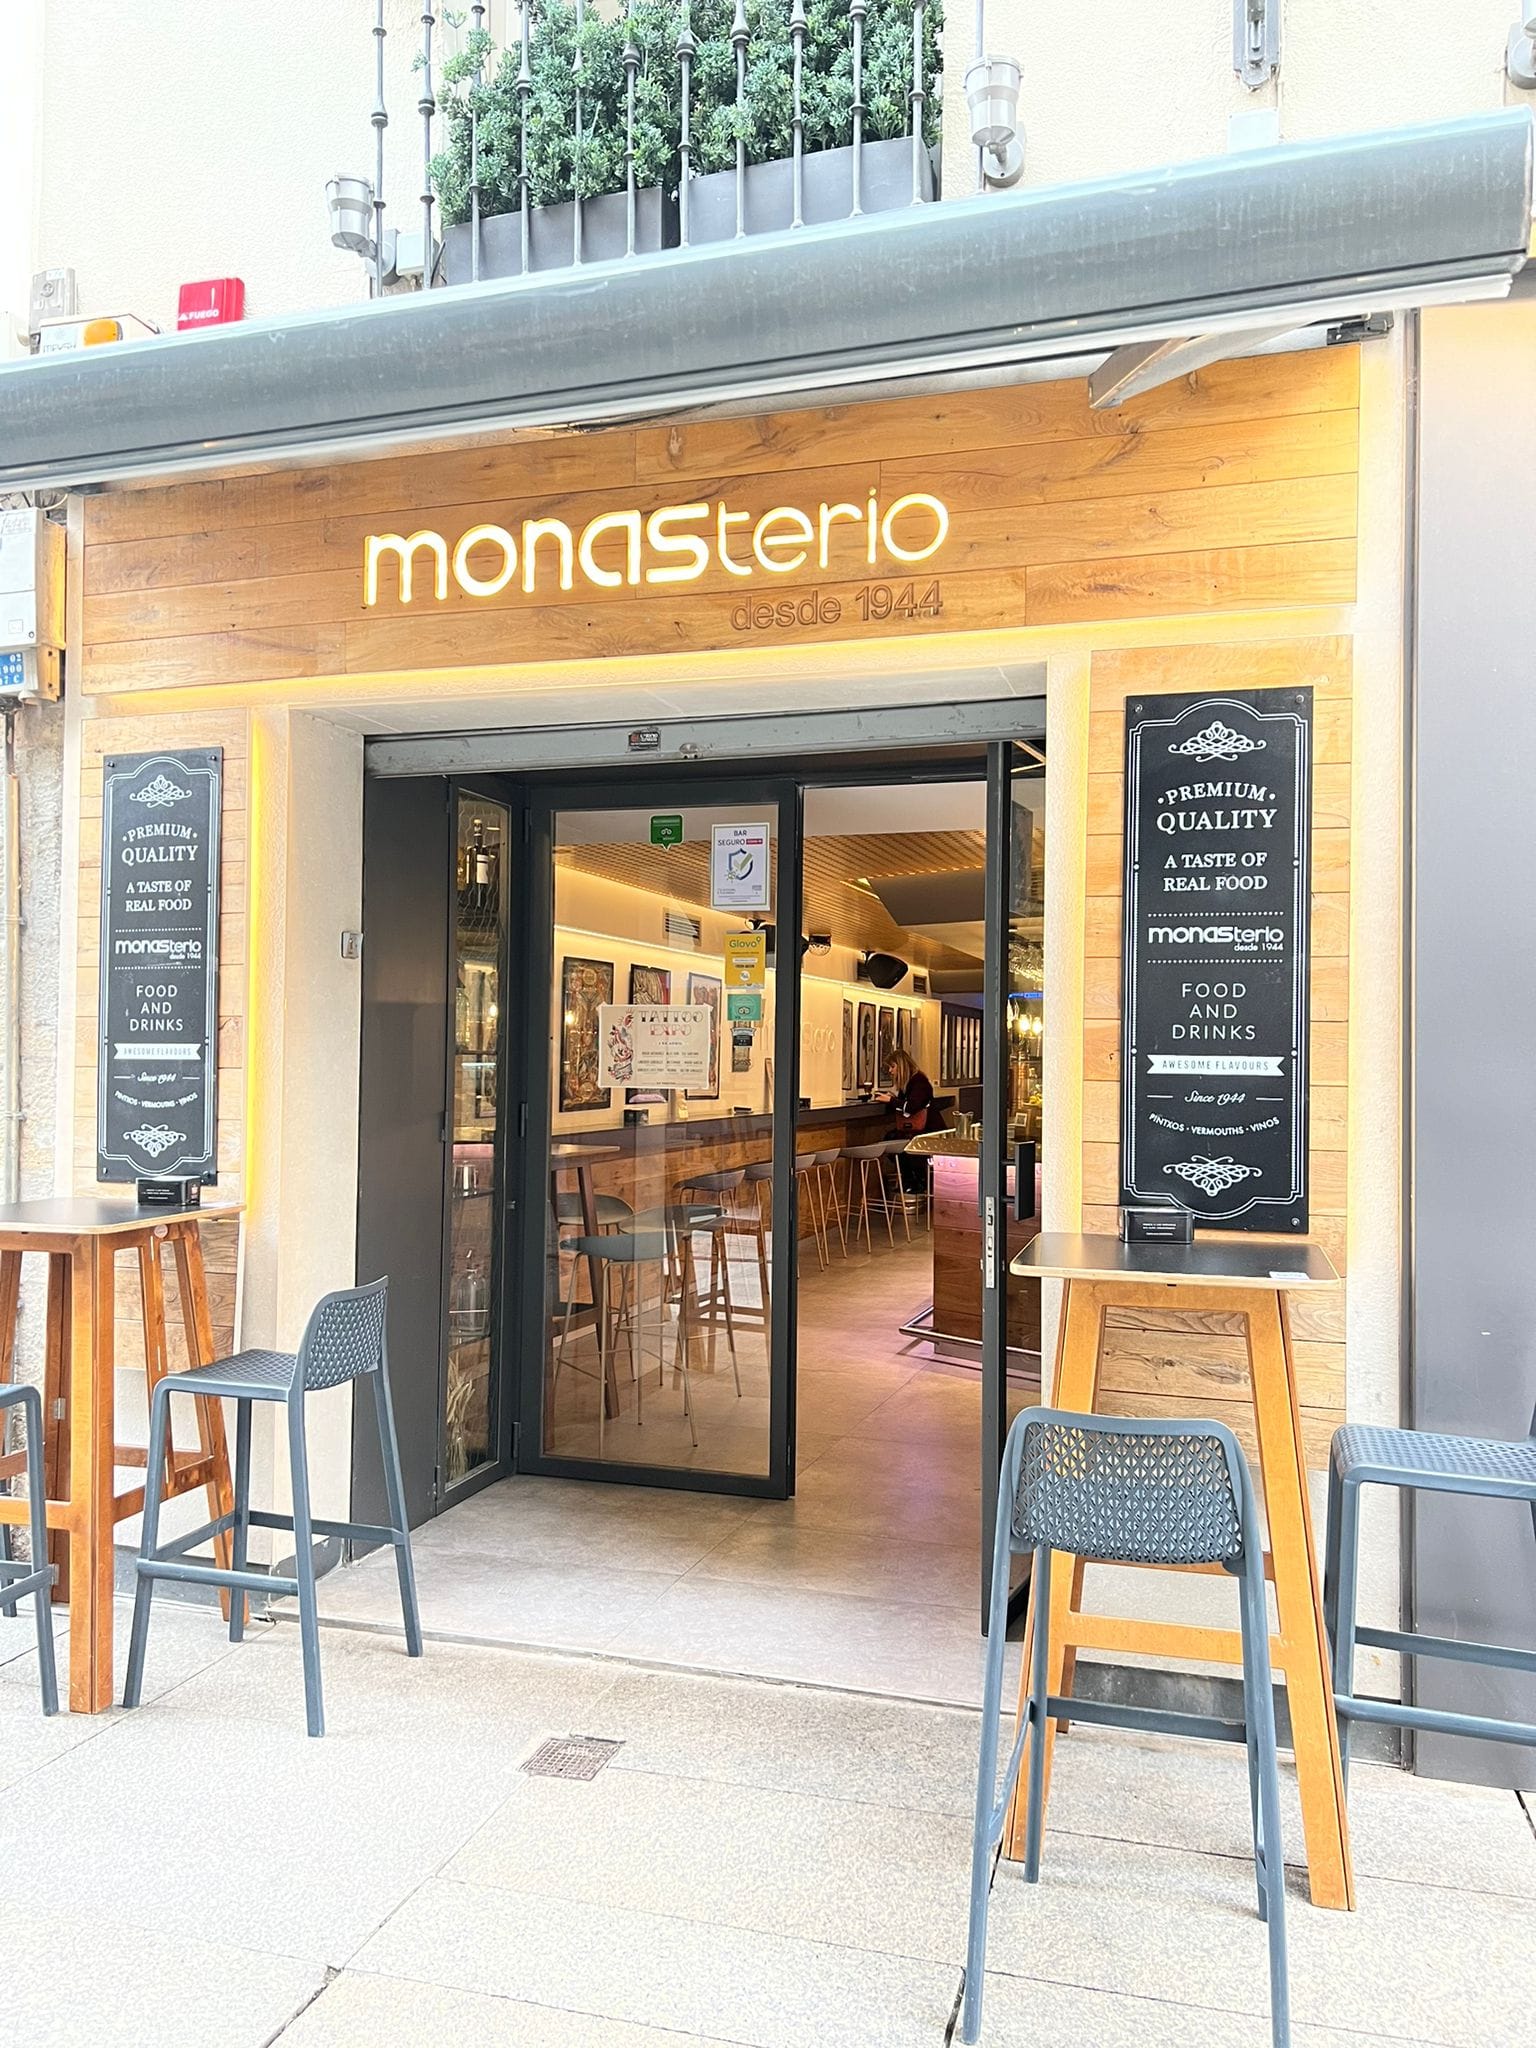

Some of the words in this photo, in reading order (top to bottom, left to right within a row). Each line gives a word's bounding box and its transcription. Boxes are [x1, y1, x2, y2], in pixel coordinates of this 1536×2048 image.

[188, 309, 219, 320] FUEGO
[364, 488, 949, 606] monasterio
[731, 590, 842, 631] desde
[855, 580, 944, 622] 1944
[1166, 782, 1268, 805] PREMIUM
[1156, 809, 1278, 834] QUALITY
[127, 823, 192, 842] PREMIUM
[717, 838, 746, 846] SEGURO
[121, 845, 199, 866] QUALITY
[1164, 855, 1177, 869] A
[1181, 854, 1236, 868] TASTE
[1241, 852, 1268, 867] OF
[126, 881, 135, 894] A
[136, 880, 172, 893] TASTE
[175, 880, 192, 893] OF
[1163, 877, 1211, 892] REAL
[1214, 875, 1268, 891] FOOD
[125, 899, 156, 912] REAL
[158, 899, 192, 912] FOOD
[1148, 926, 1284, 944] monasterio
[115, 939, 202, 954] monasterio
[729, 939, 757, 948] Glovo
[1233, 943, 1258, 951] desde
[1262, 942, 1284, 951] 1944
[136, 984, 178, 998] FOOD
[1182, 982, 1247, 998] FOOD
[141, 1002, 172, 1014] AND
[1189, 1003, 1238, 1019] AND
[639, 1010, 704, 1023] TATTOO
[129, 1018, 184, 1031] DRINKS
[650, 1023, 692, 1036] EXPO
[1172, 1025, 1256, 1040] DRINKS
[123, 1047, 155, 1056] AWESOME
[1162, 1059, 1211, 1070] AWESOME
[1215, 1060, 1269, 1071] FLAVOURS
[137, 1071, 157, 1082] Since
[1184, 1090, 1215, 1103] Since
[1216, 1093, 1246, 1105] 1944
[1149, 1113, 1185, 1132] PINTXOS
[1191, 1125, 1244, 1136] VERMOUTHS
[1249, 1116, 1280, 1132] VINOS
